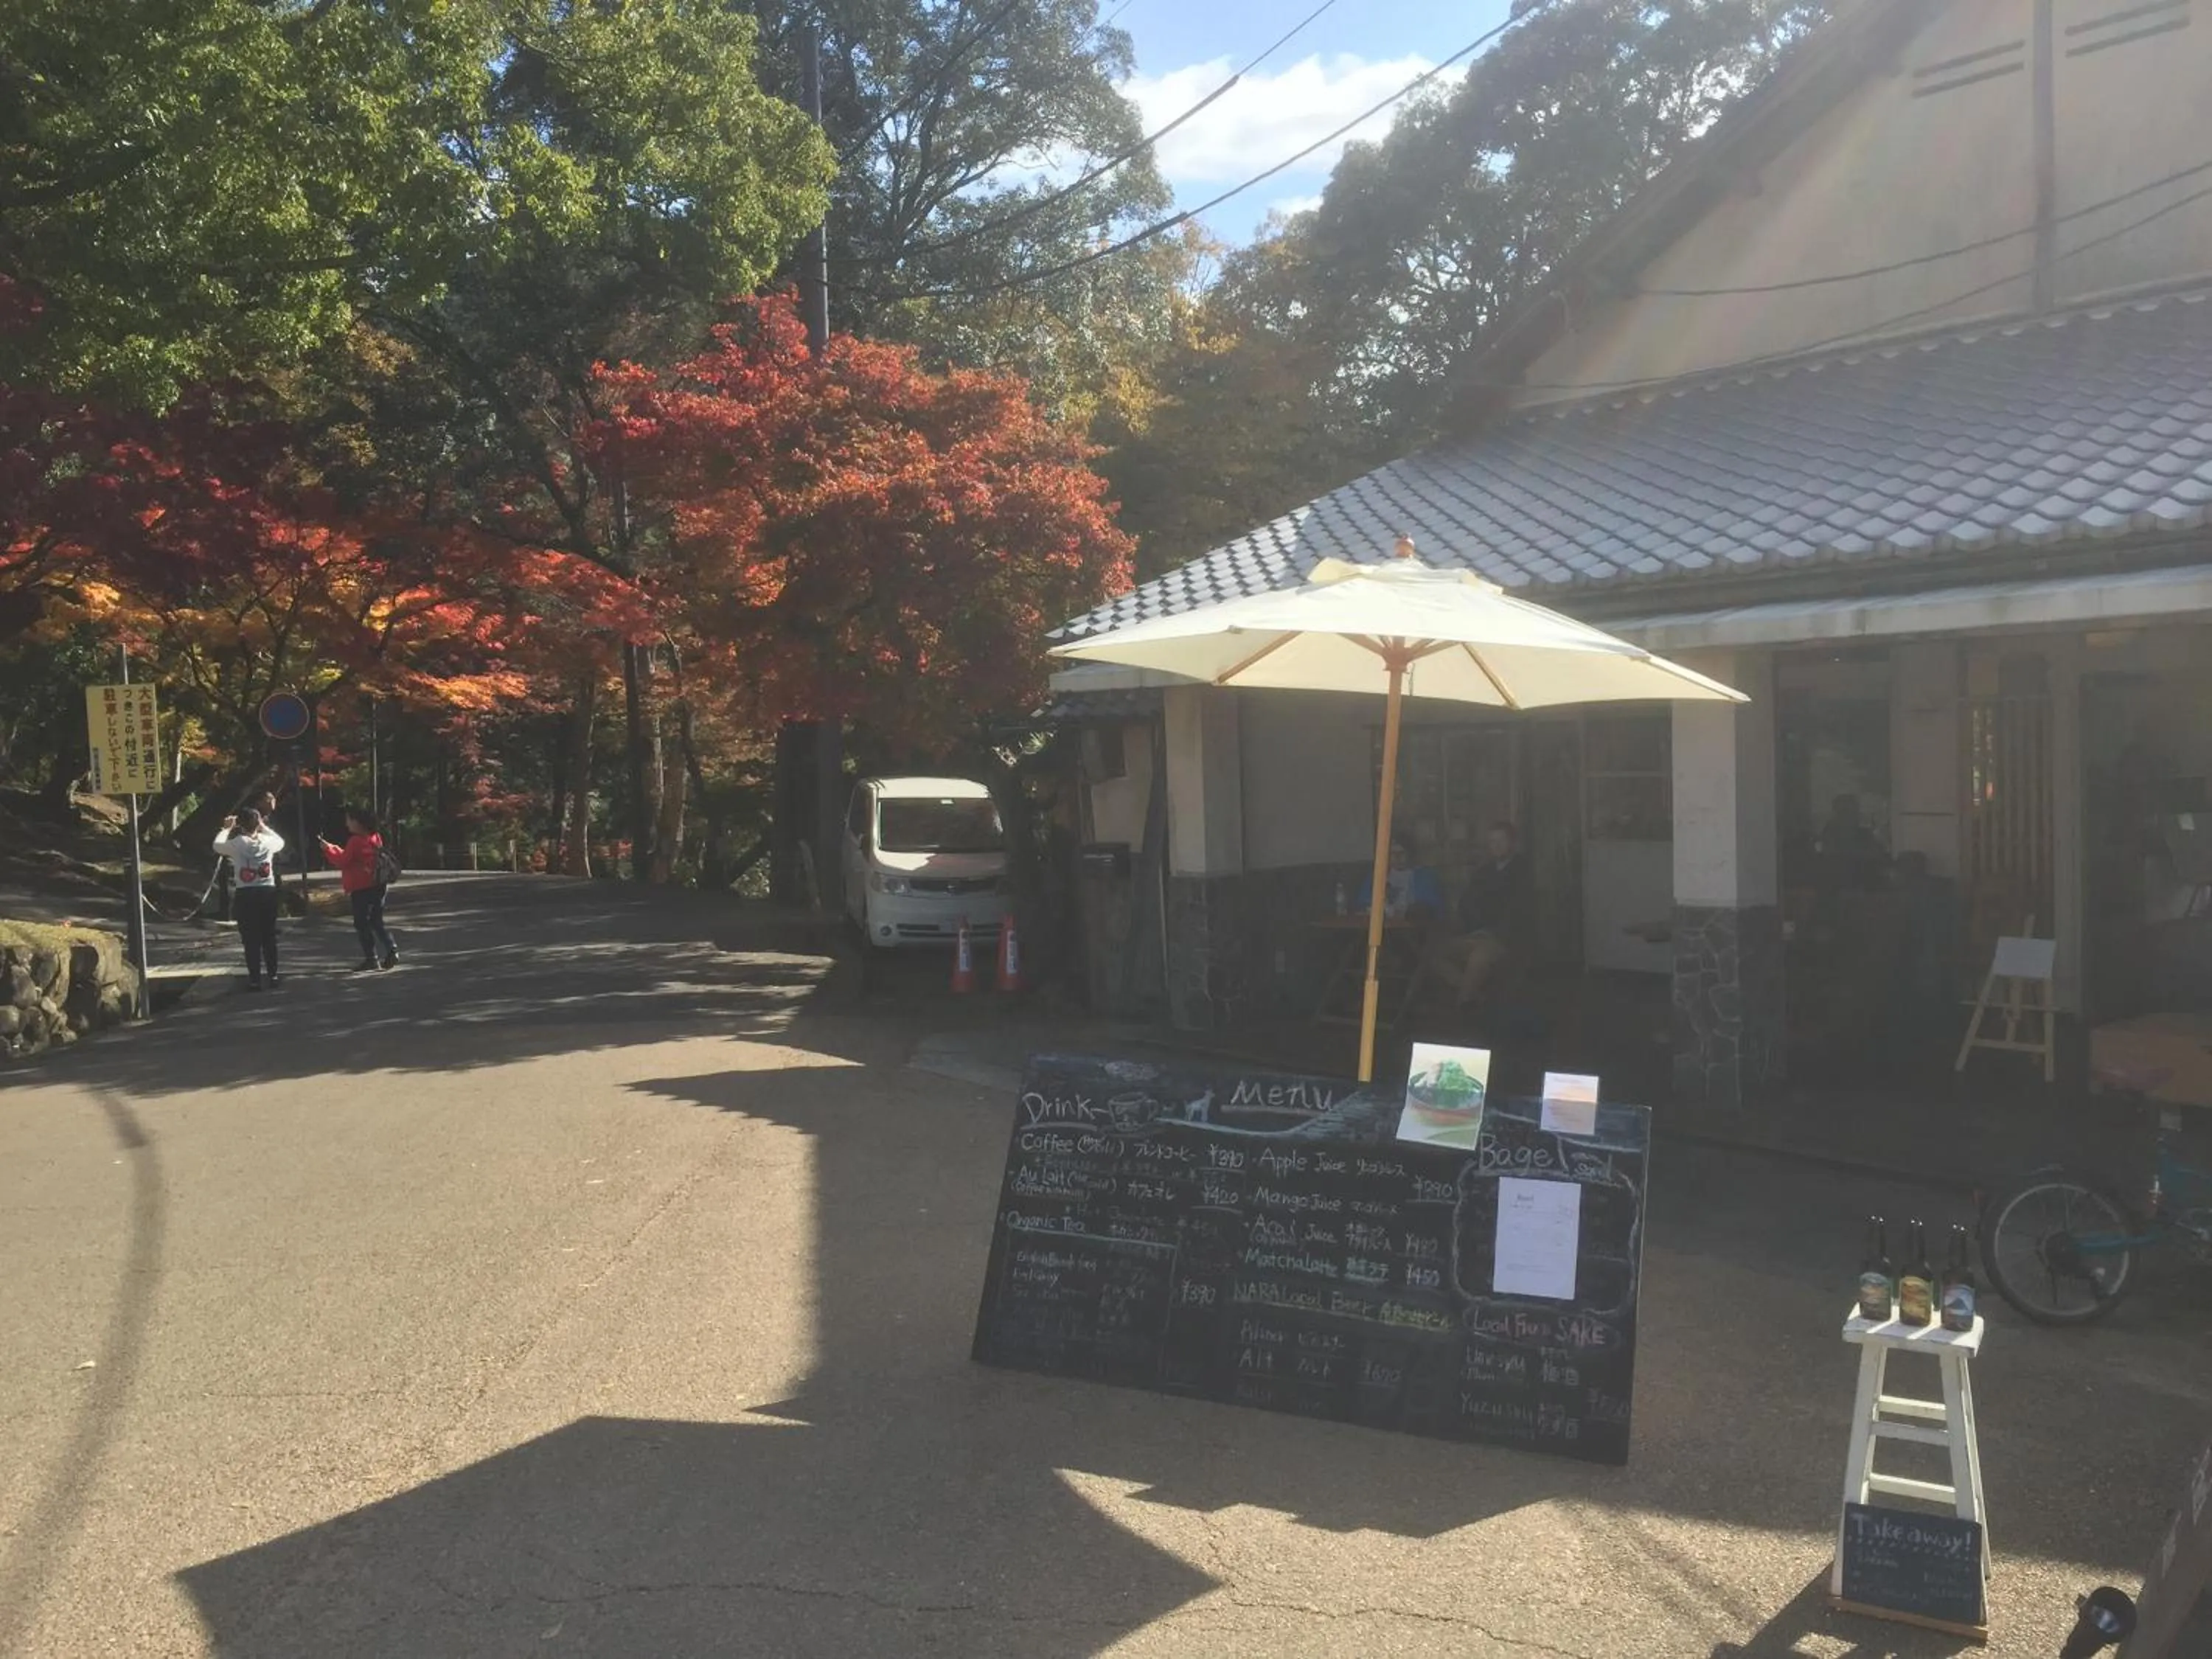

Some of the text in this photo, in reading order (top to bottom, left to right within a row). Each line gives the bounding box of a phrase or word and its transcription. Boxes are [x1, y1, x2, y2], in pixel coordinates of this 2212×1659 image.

[1022, 1092, 1096, 1124] Drink
[1231, 1080, 1333, 1110] Menu
[1021, 1133, 1074, 1152] Coffee
[1478, 1133, 1569, 1177] Bagel
[1260, 1147, 1307, 1177] Apple
[1314, 1152, 1346, 1172] Juice
[1256, 1186, 1309, 1214] Mango
[1310, 1192, 1342, 1211] Juice
